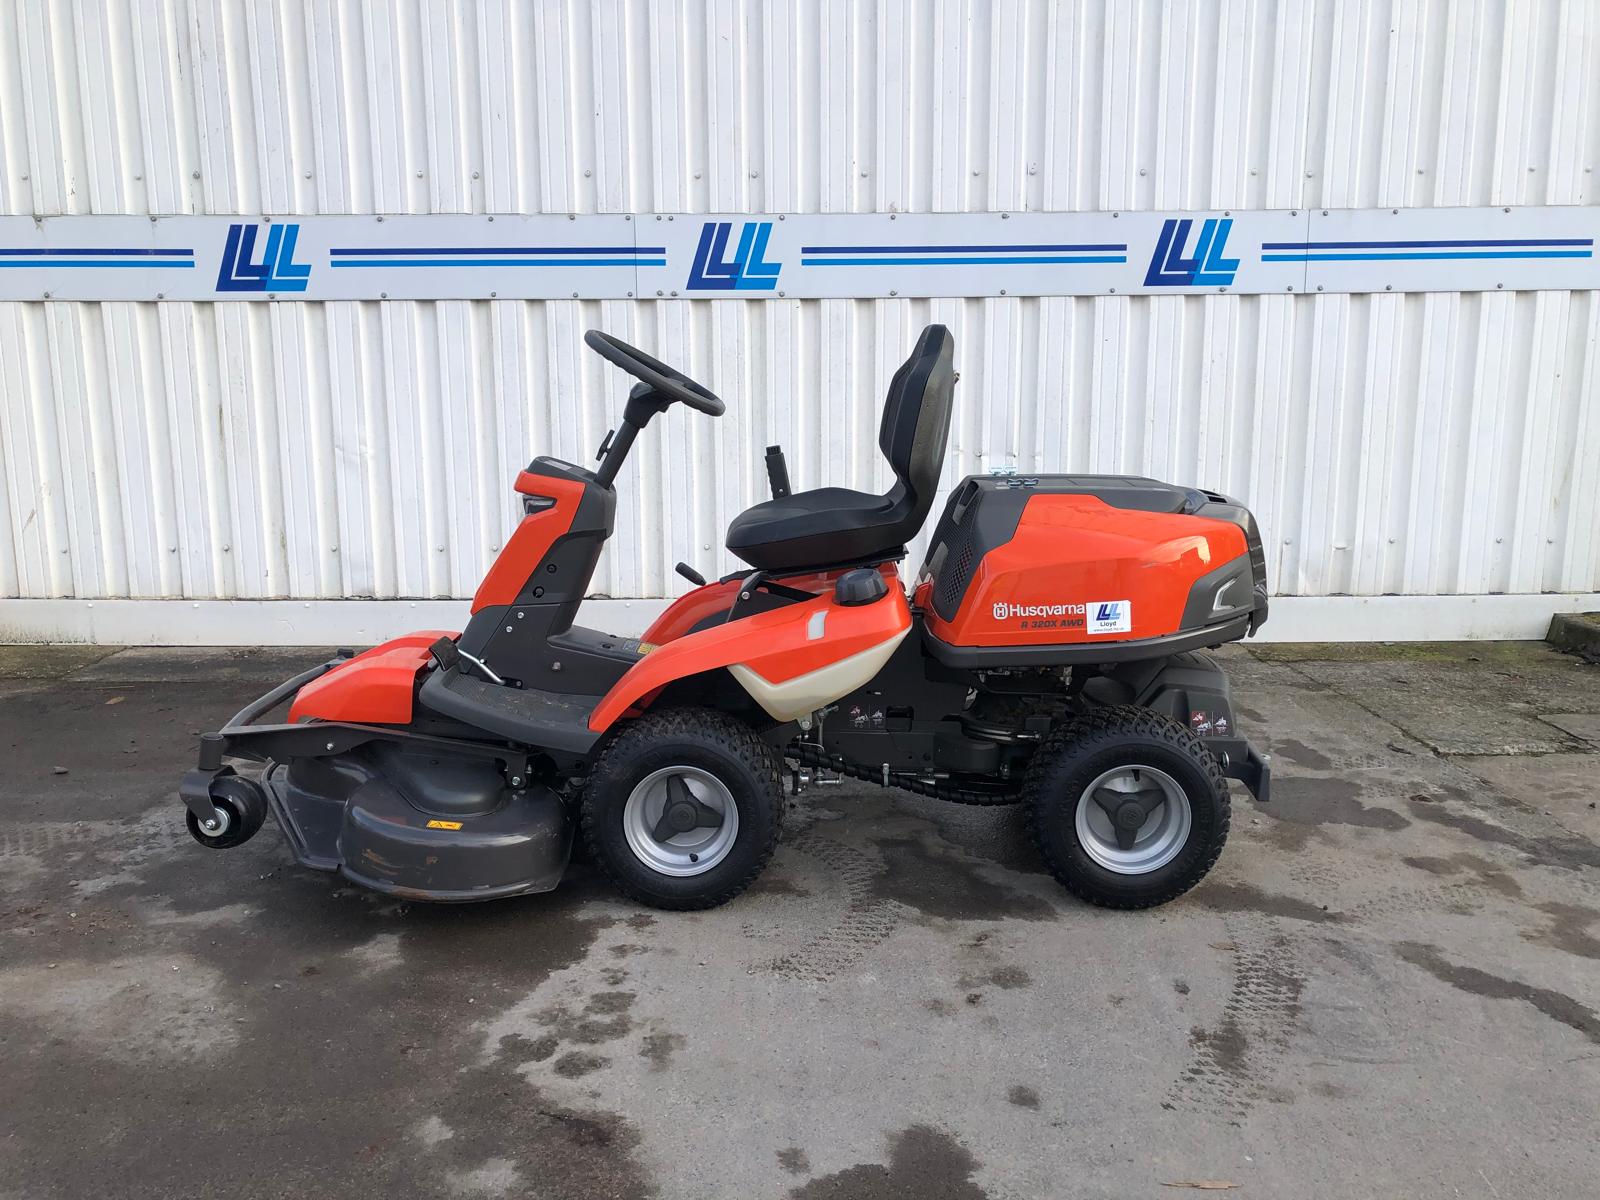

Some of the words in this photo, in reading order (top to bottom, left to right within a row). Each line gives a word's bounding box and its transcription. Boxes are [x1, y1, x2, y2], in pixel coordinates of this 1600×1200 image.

[1009, 603, 1086, 618] Husqvarna
[1031, 619, 1057, 629] 320X
[1060, 618, 1084, 628] AWD
